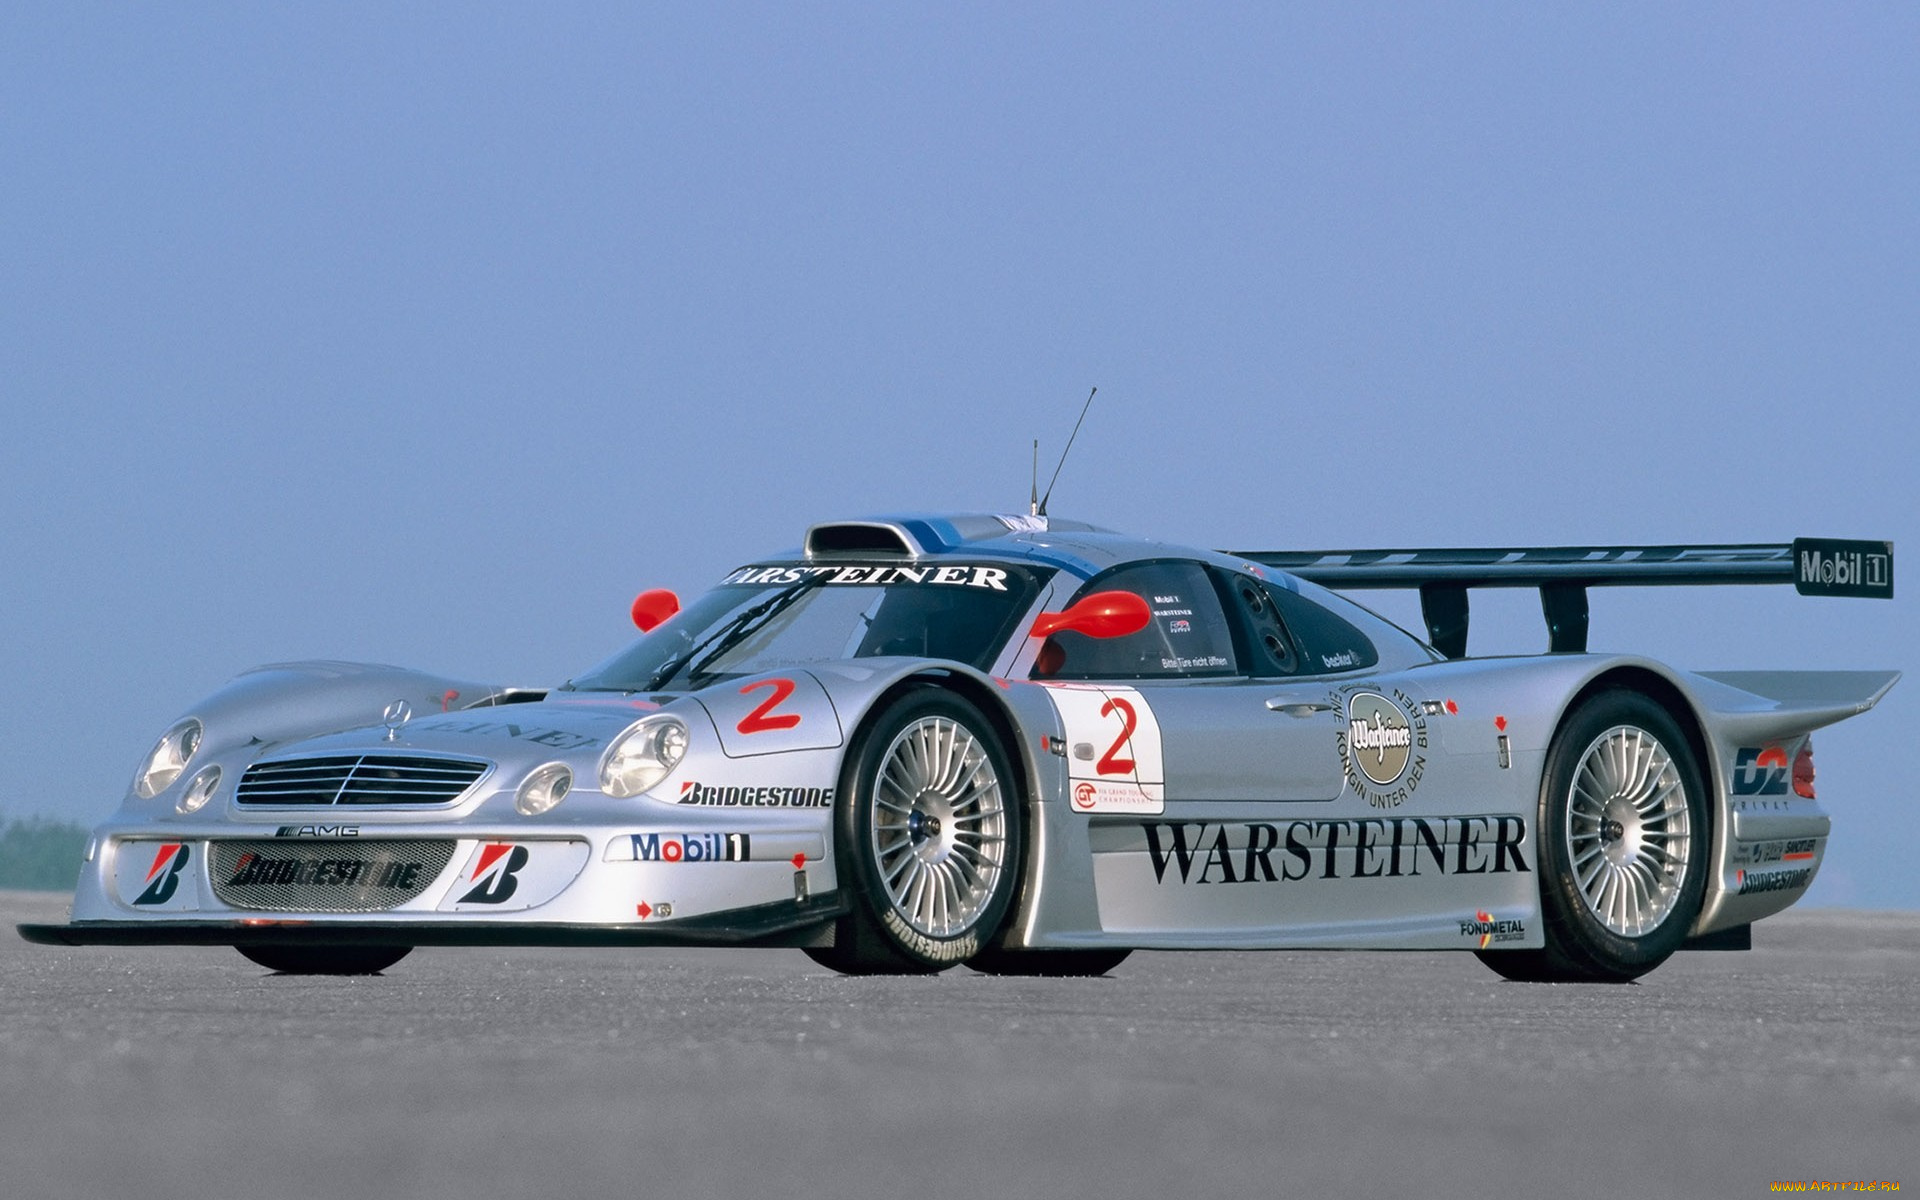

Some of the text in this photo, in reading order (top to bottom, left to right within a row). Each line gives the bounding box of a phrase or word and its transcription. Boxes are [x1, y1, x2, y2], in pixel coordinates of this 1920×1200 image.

[1801, 550, 1861, 586] Mobil
[1192, 657, 1208, 667] nicht
[1208, 656, 1228, 666] öffnen
[1322, 652, 1352, 668] becker
[736, 678, 801, 735] 2
[1328, 691, 1344, 724] EINE
[1393, 688, 1428, 749] BIEREN
[1096, 697, 1137, 776] 2
[1407, 756, 1427, 792] DEN
[1731, 747, 1788, 796] D2
[678, 781, 834, 807] BRIDGESTONE
[1369, 787, 1408, 809] UNTER
[298, 826, 360, 837] AMG
[630, 833, 720, 862] Mobil
[1141, 815, 1531, 884] WARSTEINER
[1460, 919, 1525, 936] FONDMETAL
